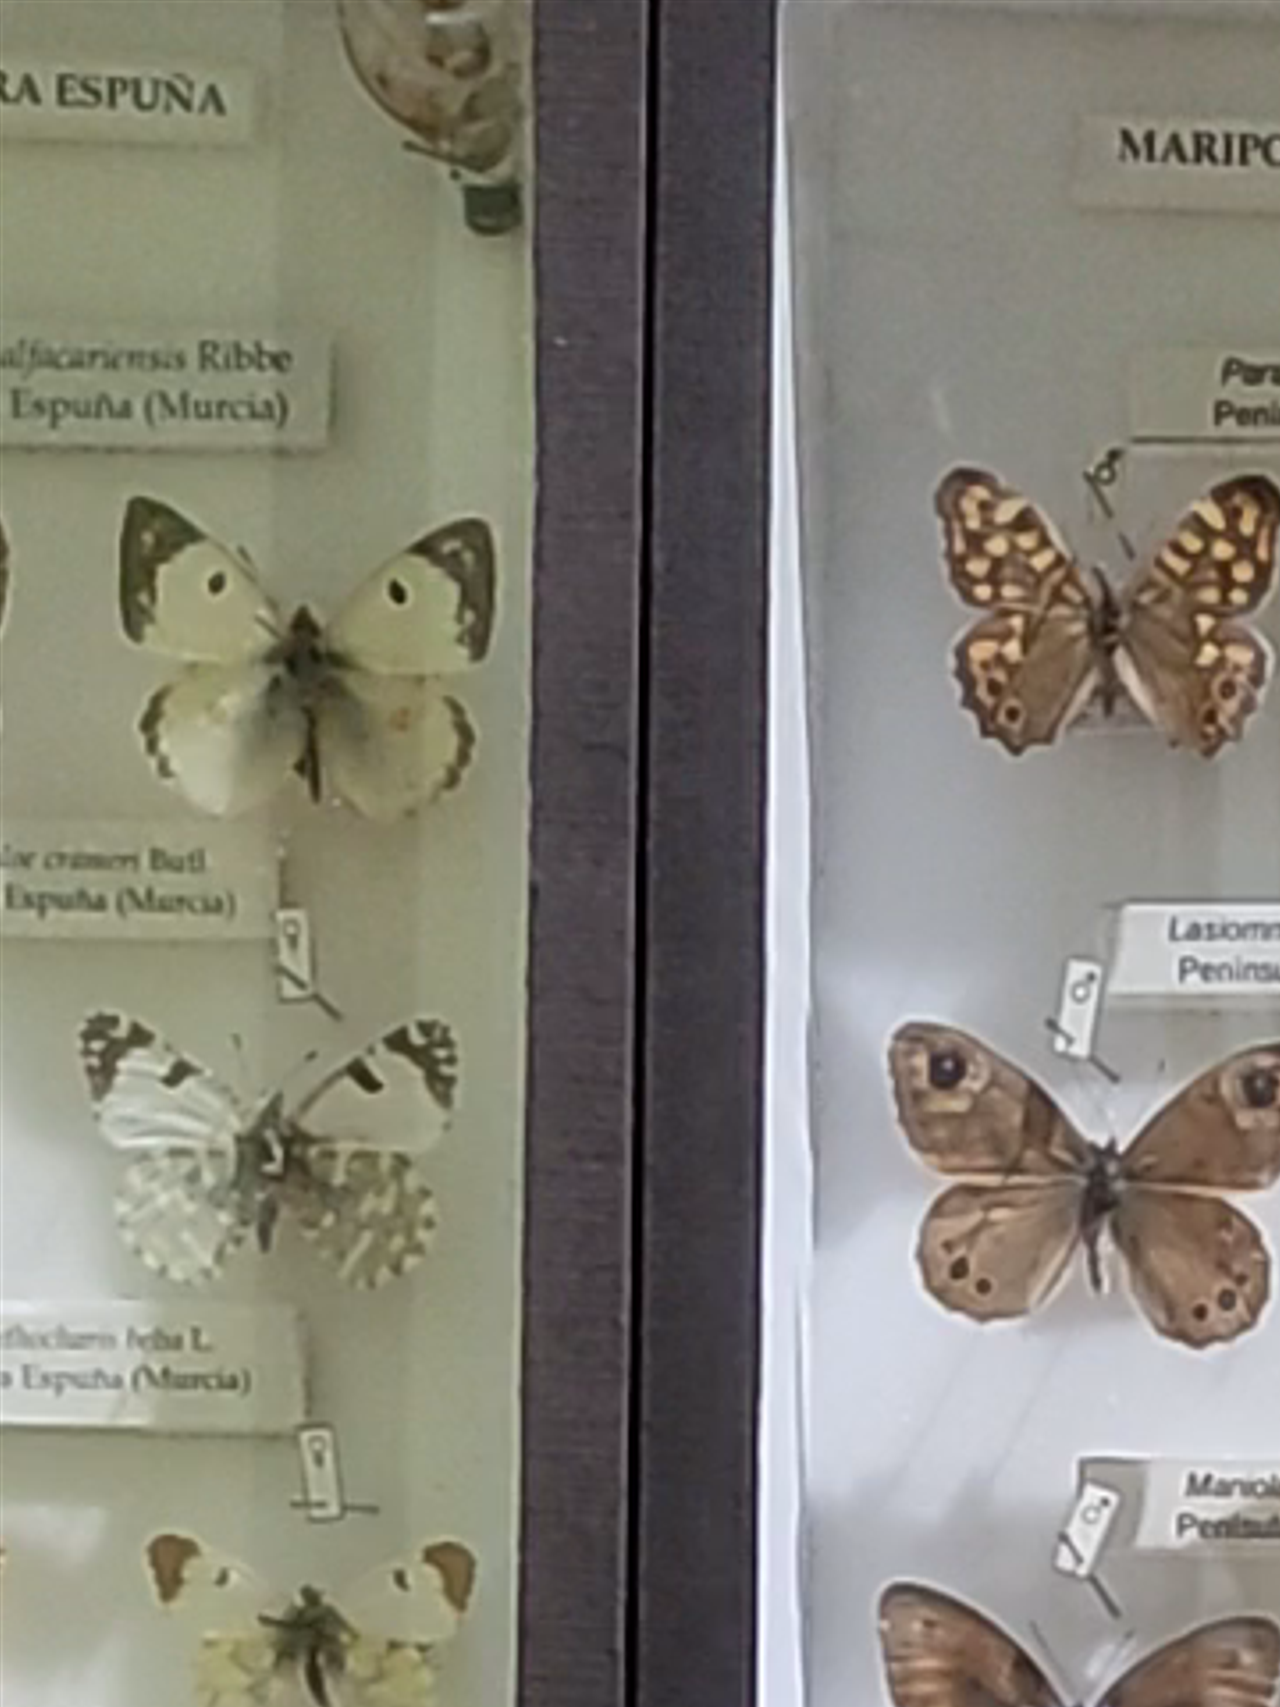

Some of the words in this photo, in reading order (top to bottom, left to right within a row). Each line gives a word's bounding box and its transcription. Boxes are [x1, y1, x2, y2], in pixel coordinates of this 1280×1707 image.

[56, 73, 226, 119] ESPUÑA
[198, 341, 292, 373] Ribbe
[12, 390, 133, 430] Espuña
[144, 391, 289, 428] (Murcia)
[116, 890, 236, 919] (Murcia)
